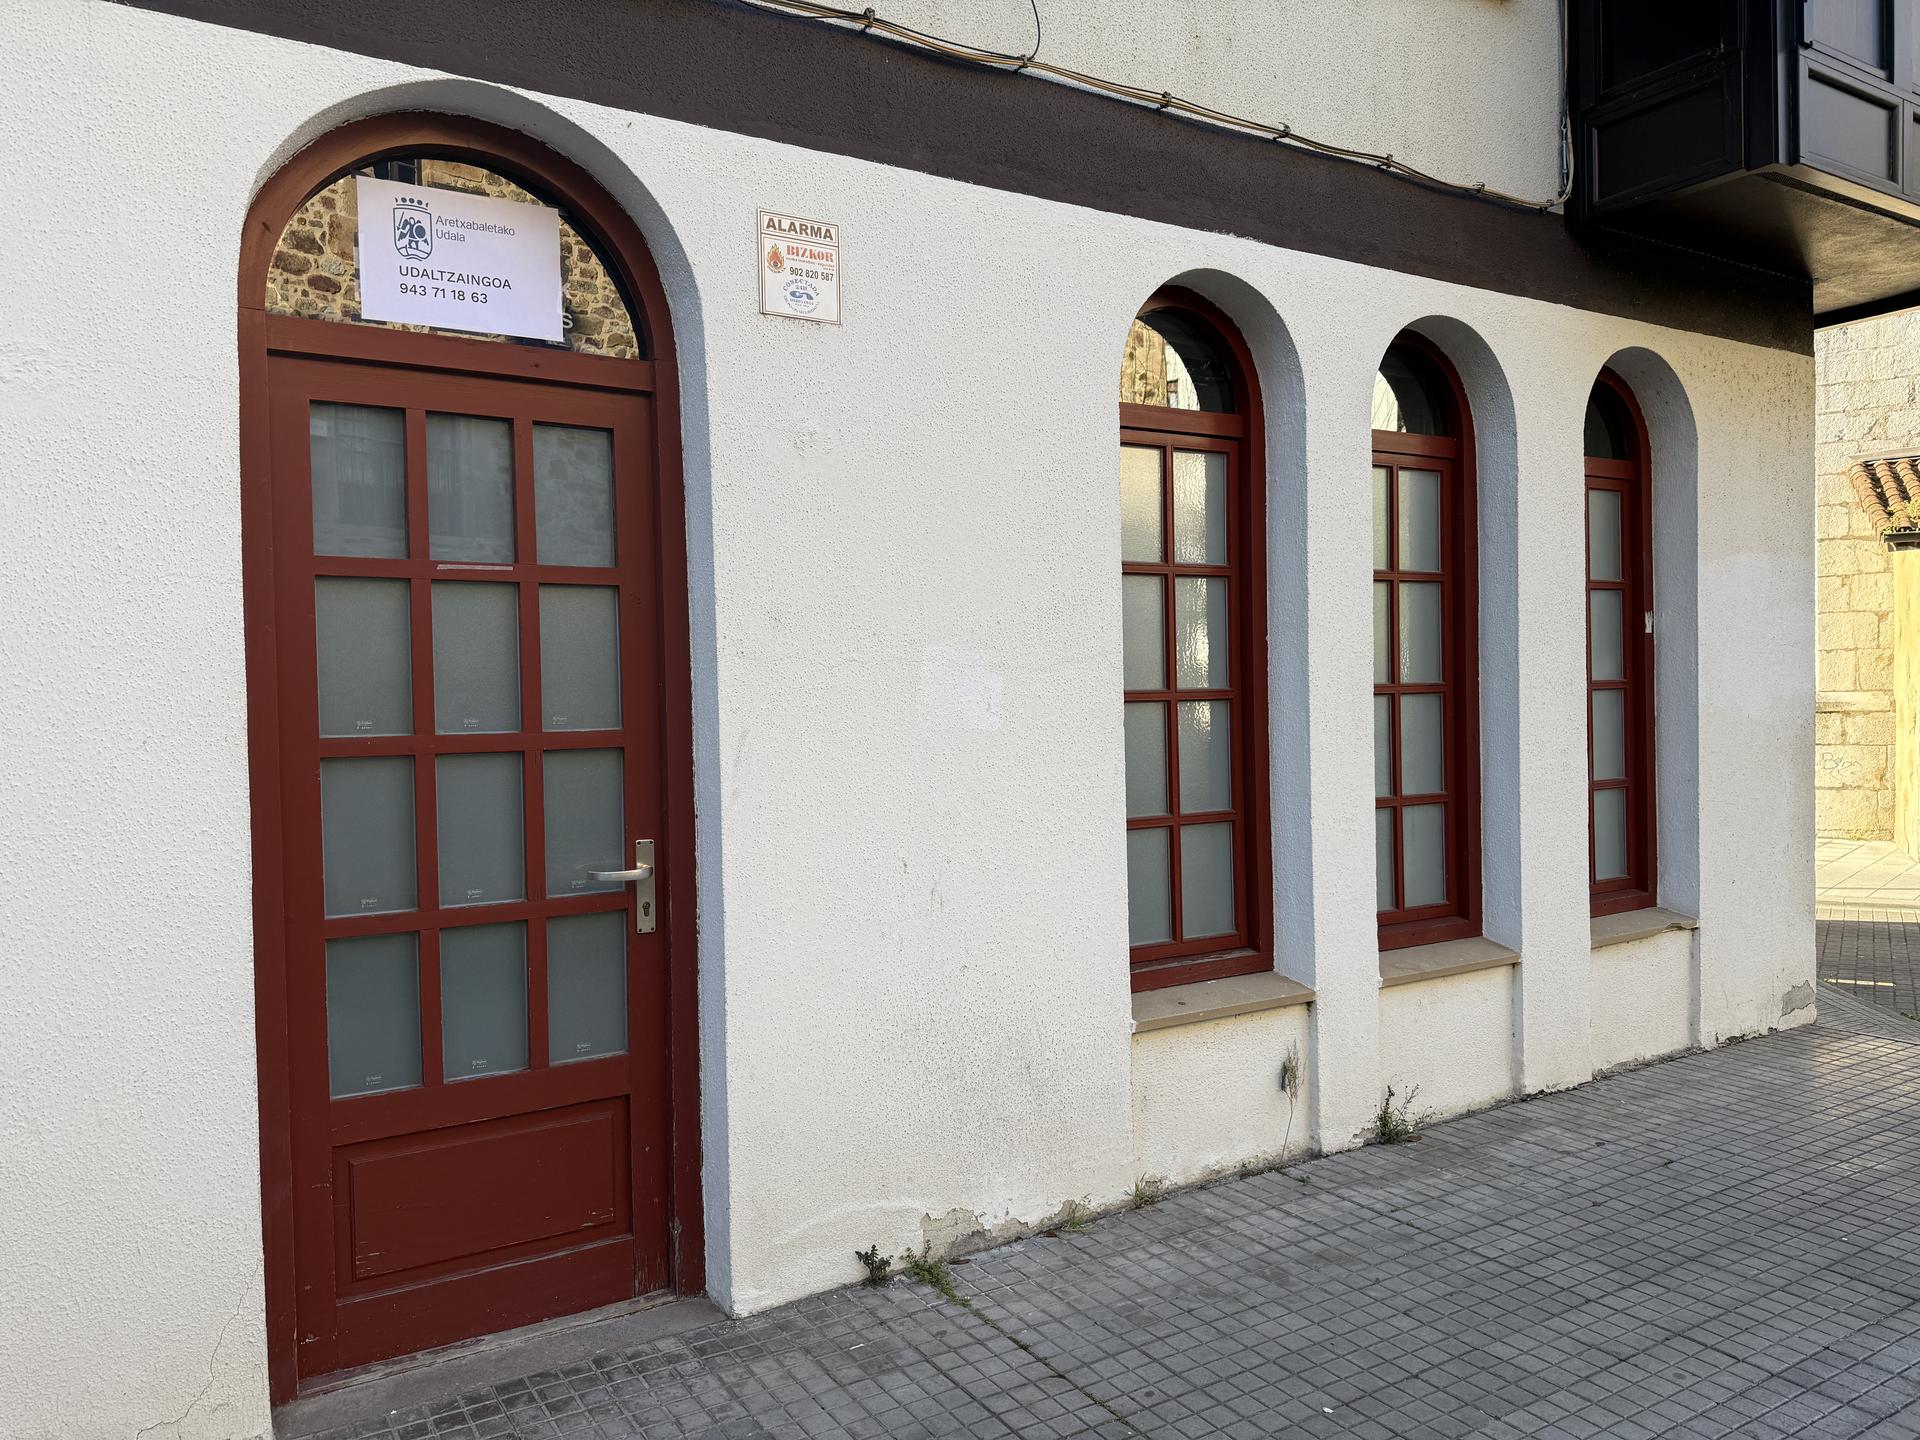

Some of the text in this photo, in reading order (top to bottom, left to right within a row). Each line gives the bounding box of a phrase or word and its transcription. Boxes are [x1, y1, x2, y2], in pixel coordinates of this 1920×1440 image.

[435, 215, 516, 236] Aretxabaletako
[436, 228, 466, 242] Udala
[766, 217, 834, 241] ALARMA
[786, 244, 834, 263] BIZKOR
[399, 265, 512, 290] UDALTZAINGOA
[789, 266, 804, 277] 902
[805, 269, 819, 280] 820
[820, 271, 834, 282] 587
[399, 282, 488, 304] 943 71 18 63
